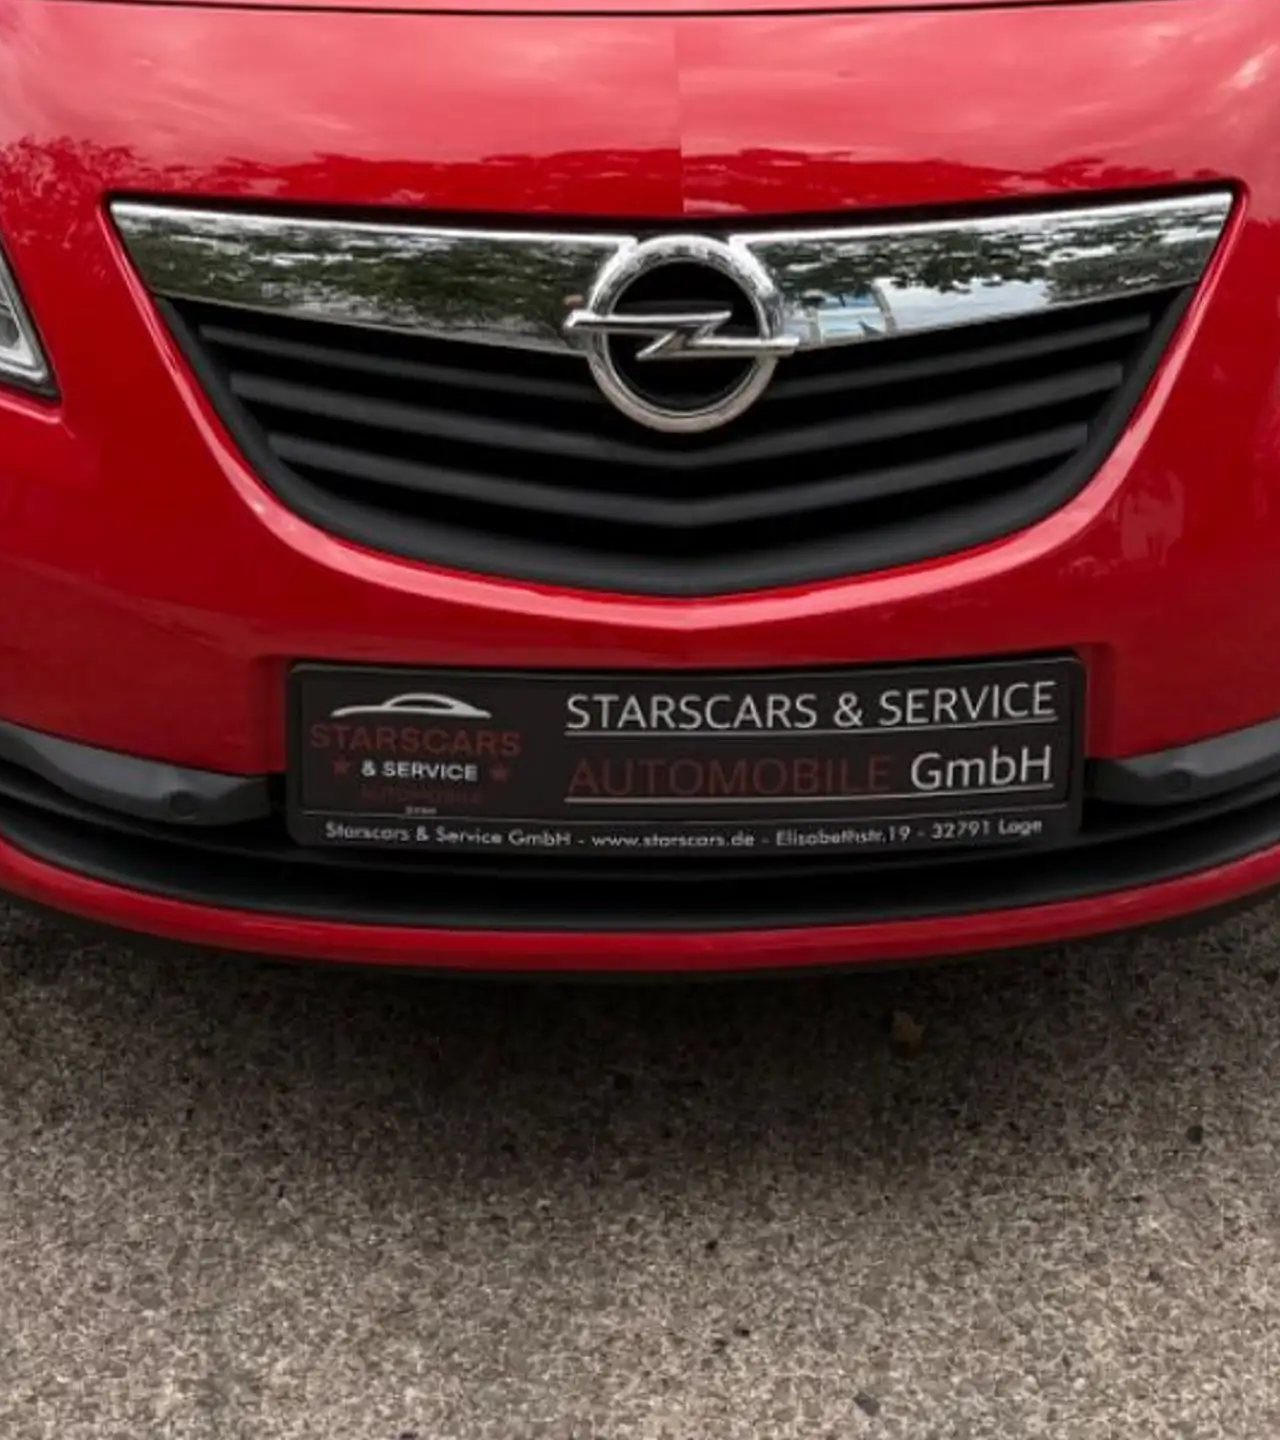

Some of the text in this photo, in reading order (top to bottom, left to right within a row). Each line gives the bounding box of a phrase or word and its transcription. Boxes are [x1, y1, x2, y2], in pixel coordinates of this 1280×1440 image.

[566, 680, 1057, 729] STARSCARS & SERVICE
[310, 724, 521, 756] STARSCARS
[361, 760, 478, 782] & SERVICE
[569, 744, 1051, 796] AUTOMOBILE GmbH
[325, 821, 410, 843] Starscars
[415, 826, 429, 841] &
[436, 825, 502, 845] Service
[508, 828, 570, 846] GmbH
[592, 830, 754, 847] www.starscars.de
[931, 820, 990, 839] 32791
